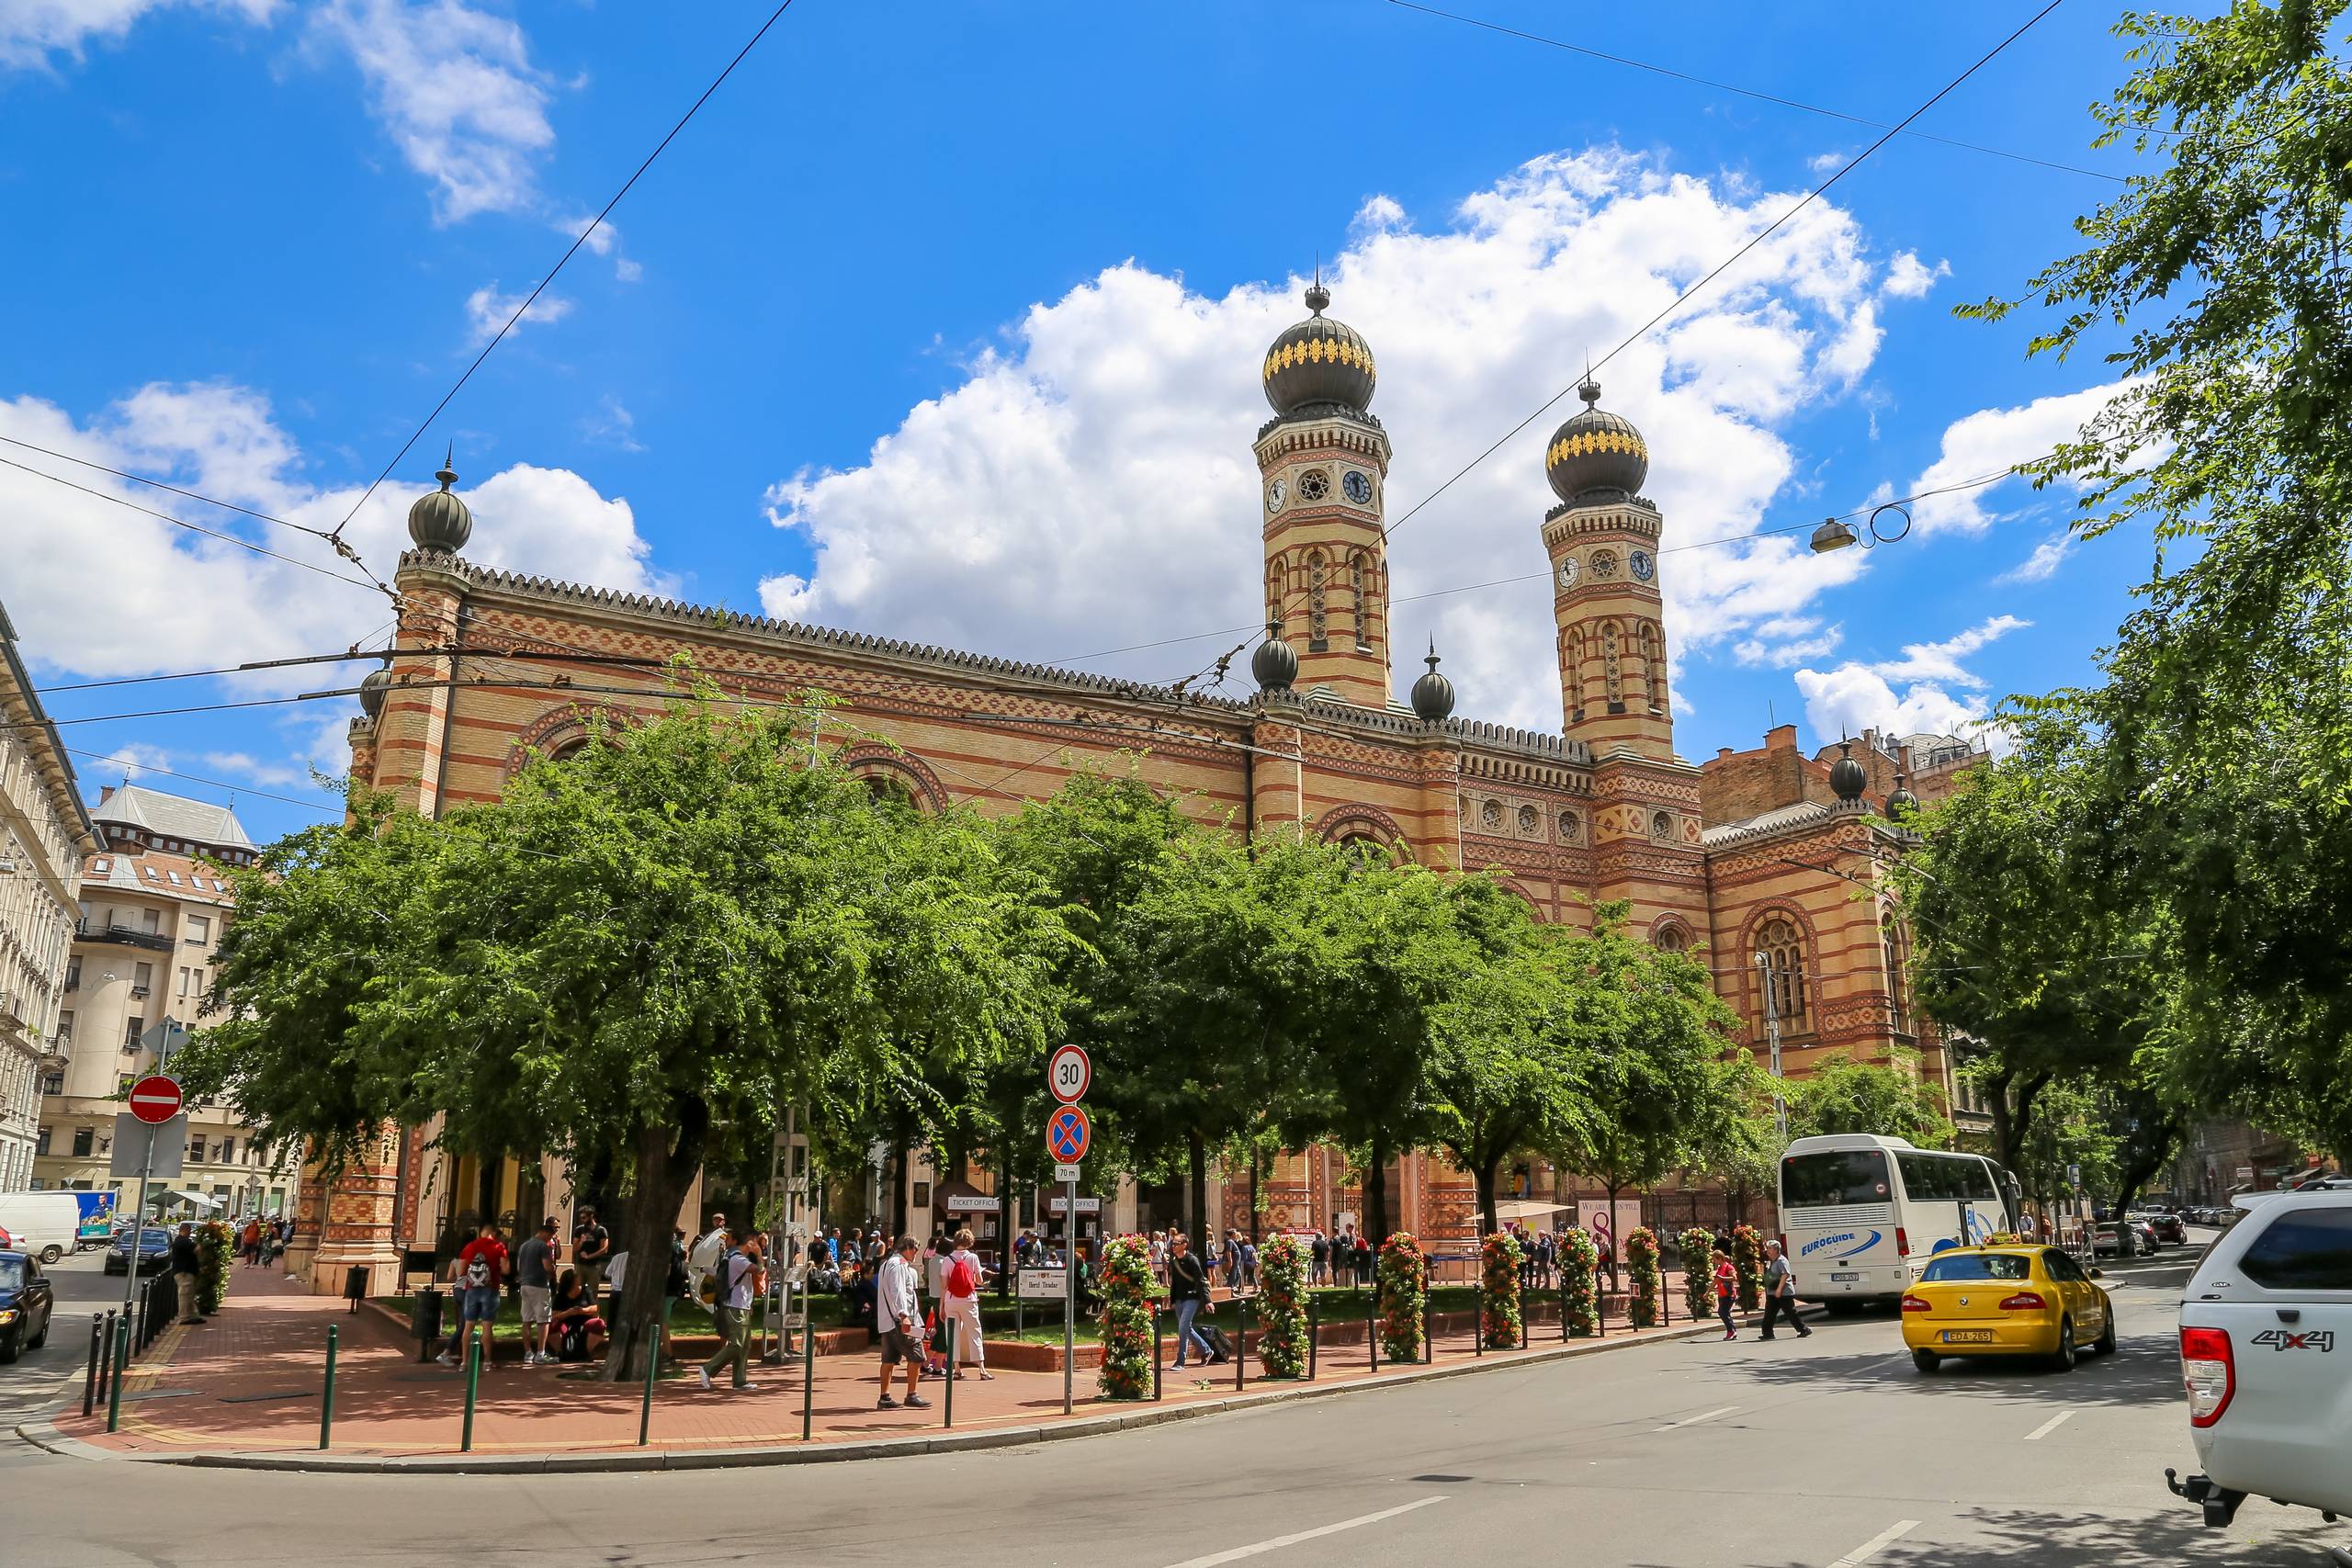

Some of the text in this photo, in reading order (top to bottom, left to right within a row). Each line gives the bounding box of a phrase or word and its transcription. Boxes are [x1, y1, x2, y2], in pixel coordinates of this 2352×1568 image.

[1059, 1064, 1080, 1085] 30
[1802, 1233, 1855, 1257] EUROGUIDE
[1950, 1332, 1988, 1340] EDA-265
